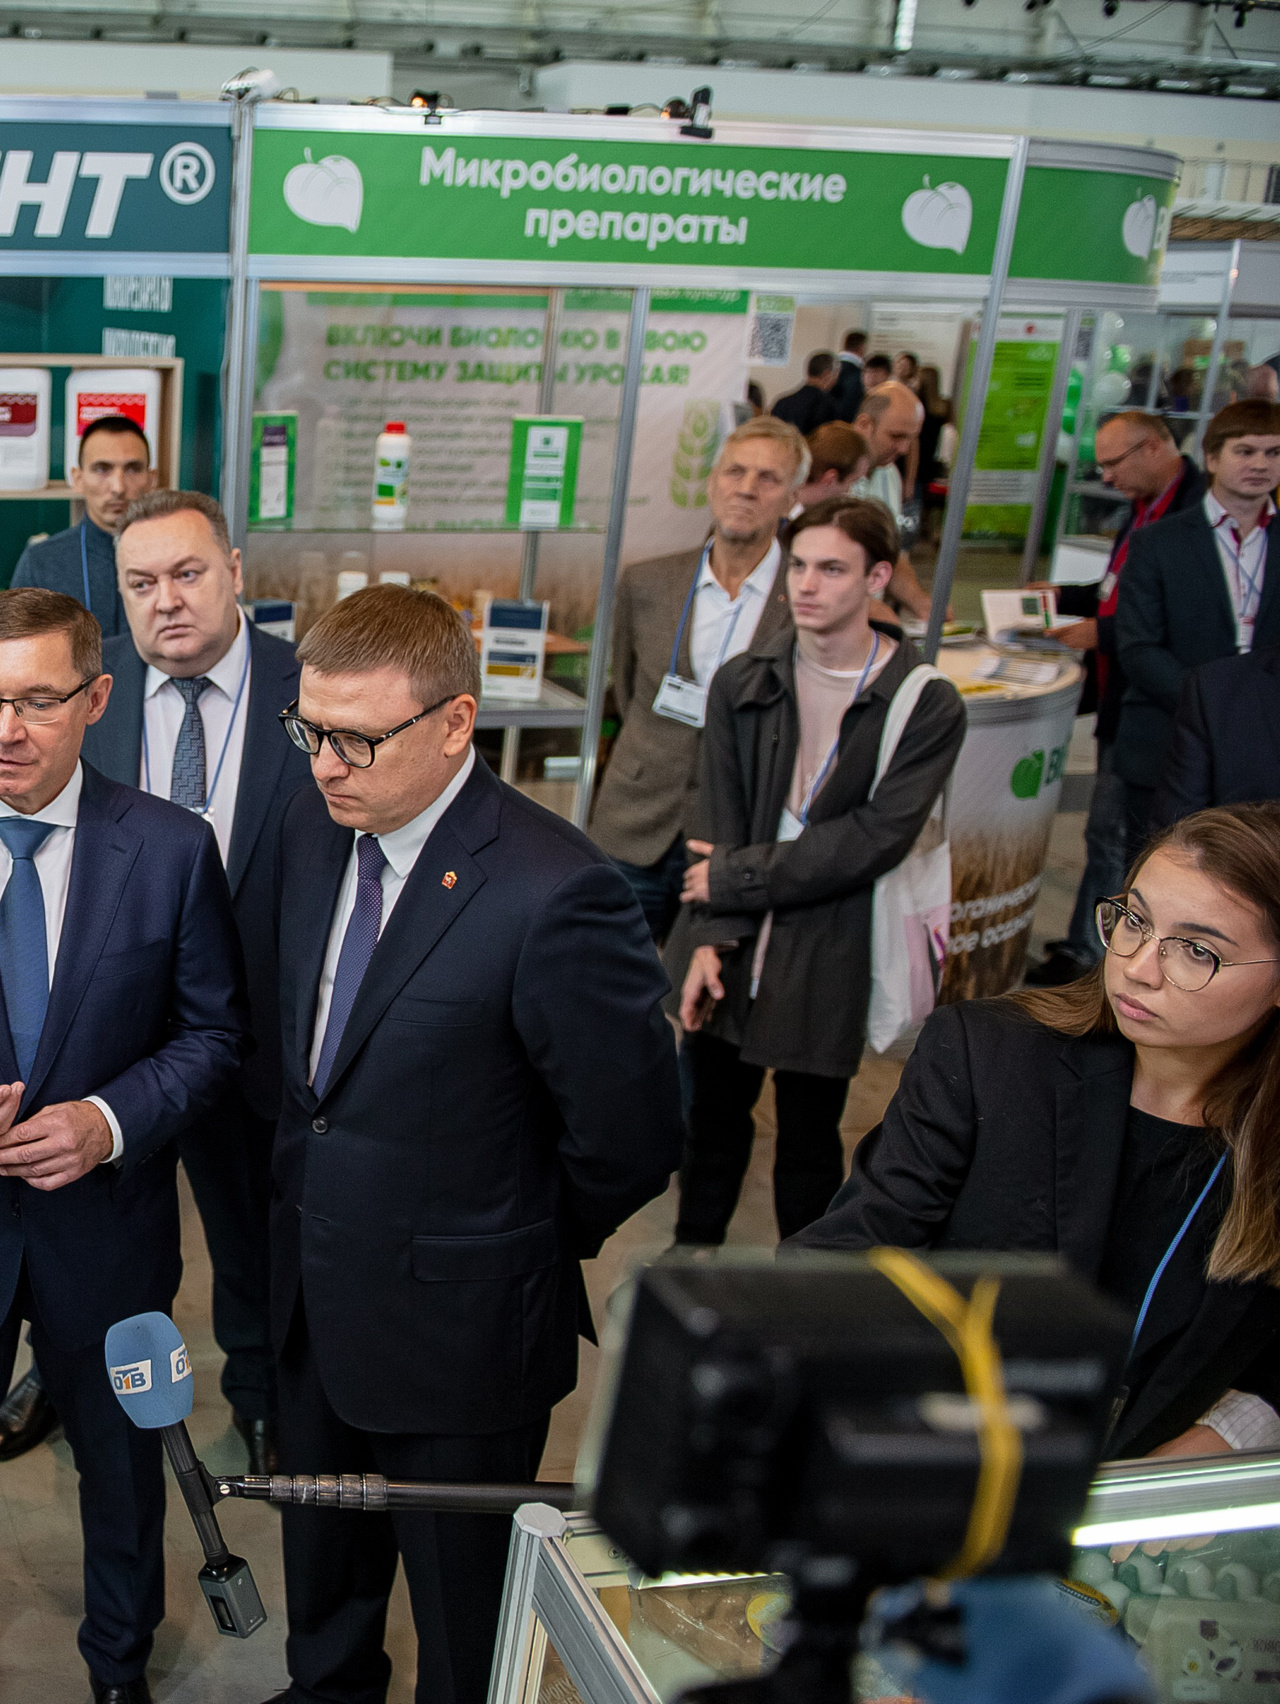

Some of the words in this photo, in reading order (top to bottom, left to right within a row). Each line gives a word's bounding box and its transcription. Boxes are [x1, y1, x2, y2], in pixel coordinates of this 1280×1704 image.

[420, 146, 848, 203] Микробиологические
[524, 207, 748, 251] препараты
[325, 324, 442, 348] ВКЛЮЧИ
[323, 359, 448, 383] СИСТЕМУ
[574, 362, 690, 386] УРОАЯ!
